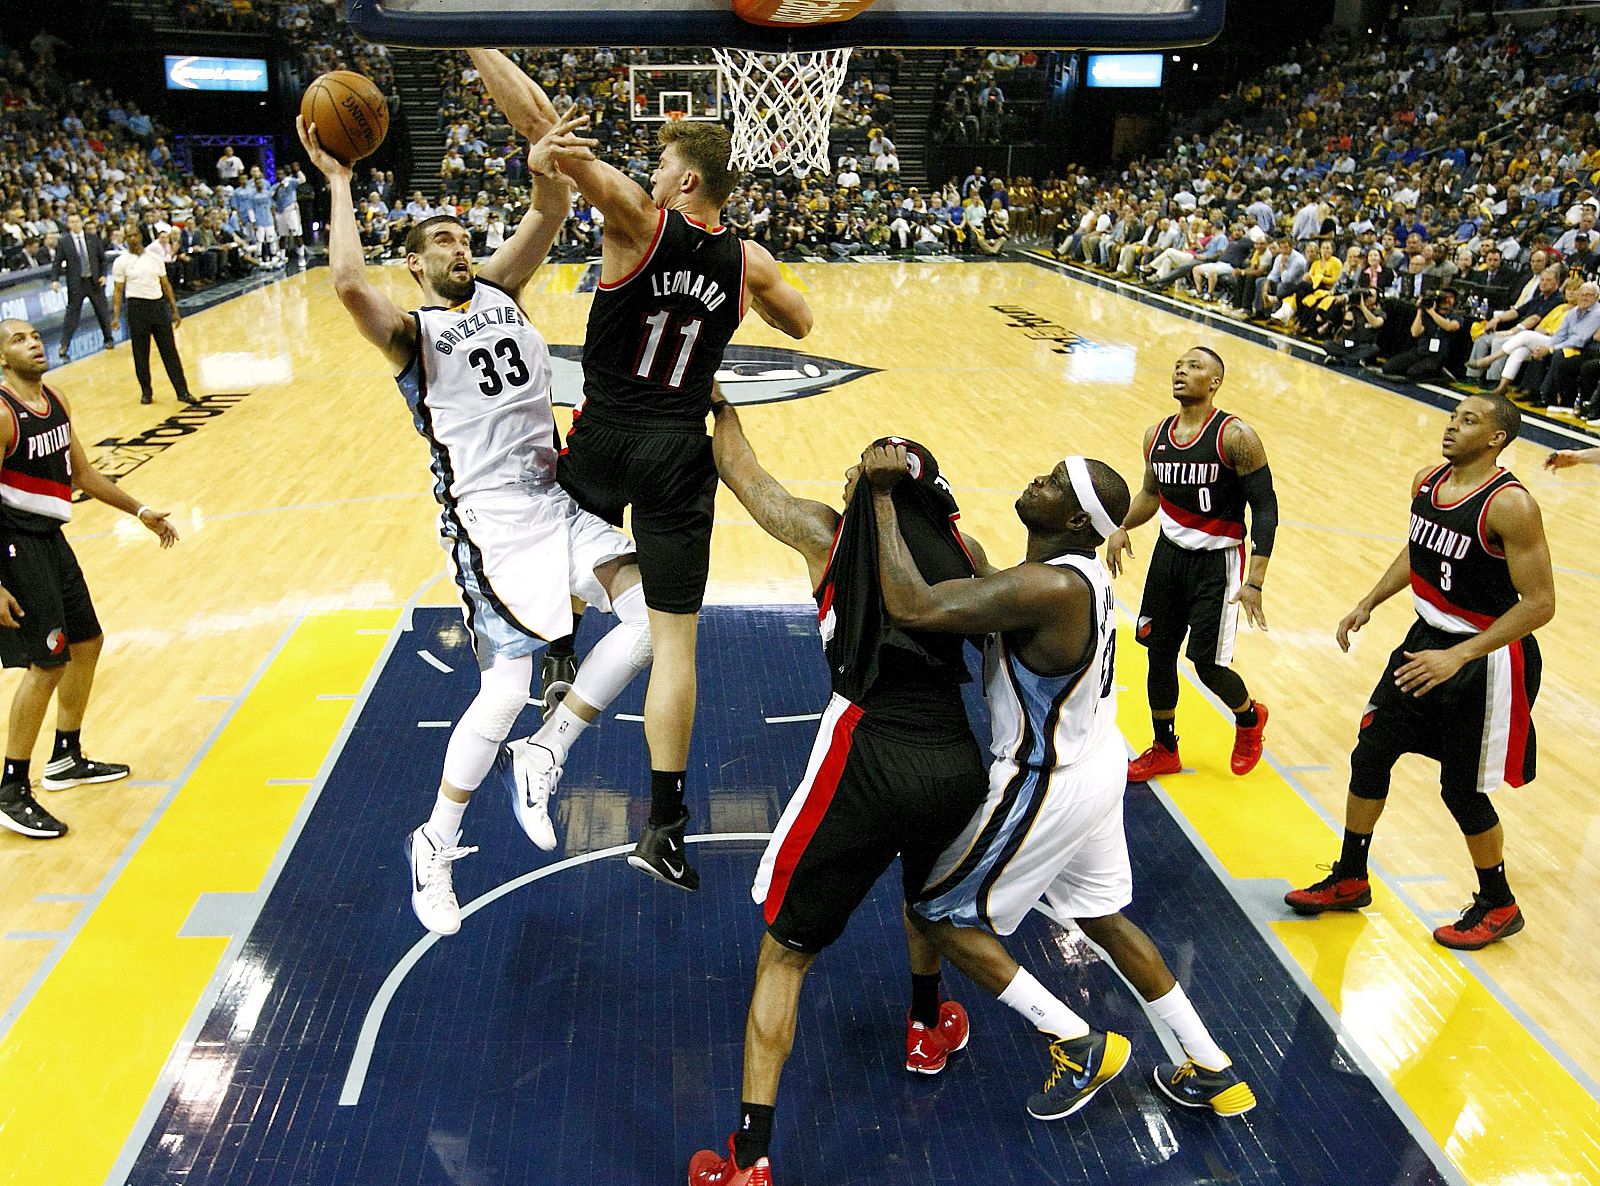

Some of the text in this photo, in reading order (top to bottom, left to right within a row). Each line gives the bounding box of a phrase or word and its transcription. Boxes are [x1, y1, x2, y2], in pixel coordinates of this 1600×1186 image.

[342, 94, 376, 148] PALDING
[651, 270, 726, 312] LEONARD
[468, 337, 530, 397] 33
[636, 310, 702, 388] 11
[28, 422, 71, 460] PORTLAN
[1198, 487, 1212, 512] 0
[1409, 513, 1472, 560] ORTLAND
[1440, 561, 1452, 591] 3
